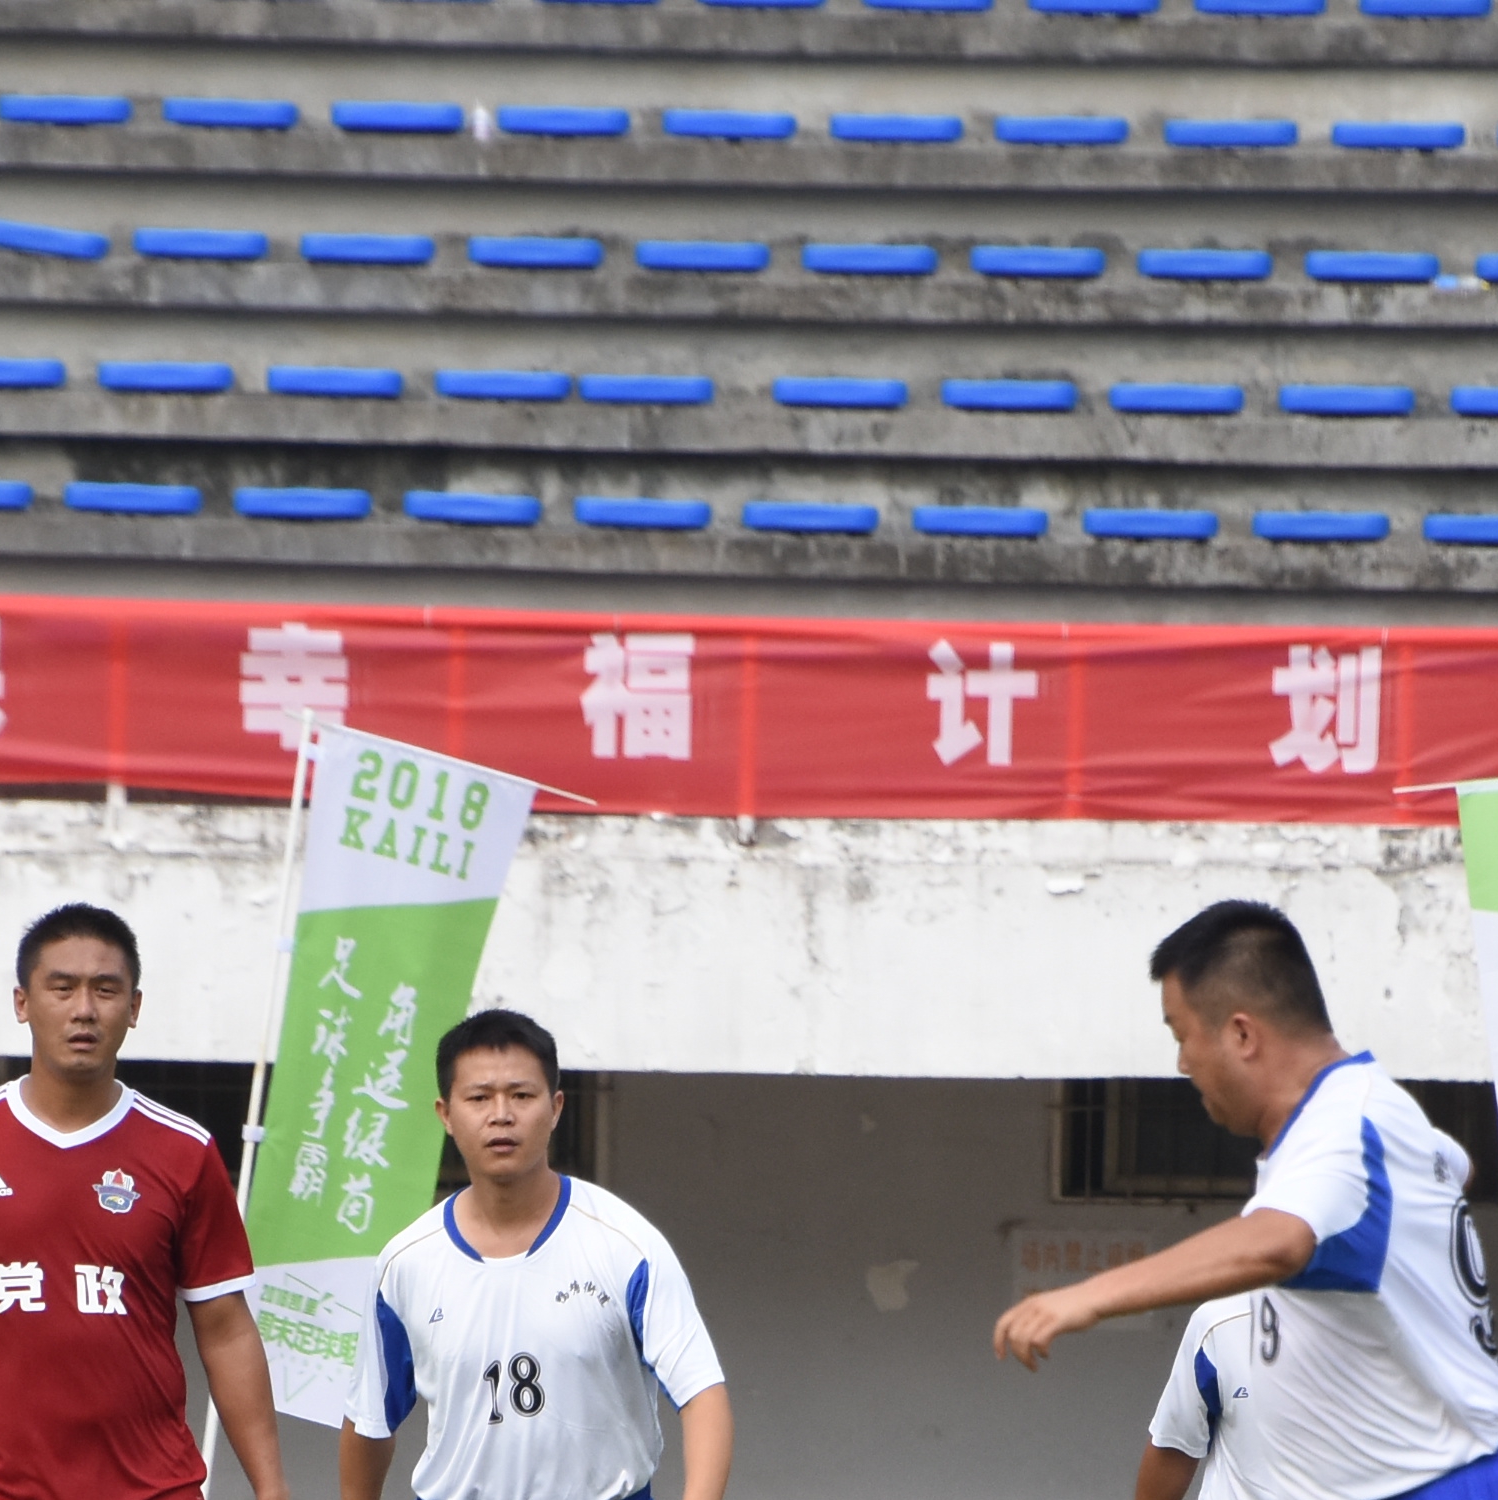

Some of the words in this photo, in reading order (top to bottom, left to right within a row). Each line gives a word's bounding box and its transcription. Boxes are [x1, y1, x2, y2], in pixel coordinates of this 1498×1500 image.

[350, 748, 491, 831] 2018
[339, 805, 475, 881] KAILI
[483, 1351, 546, 1426] 18
